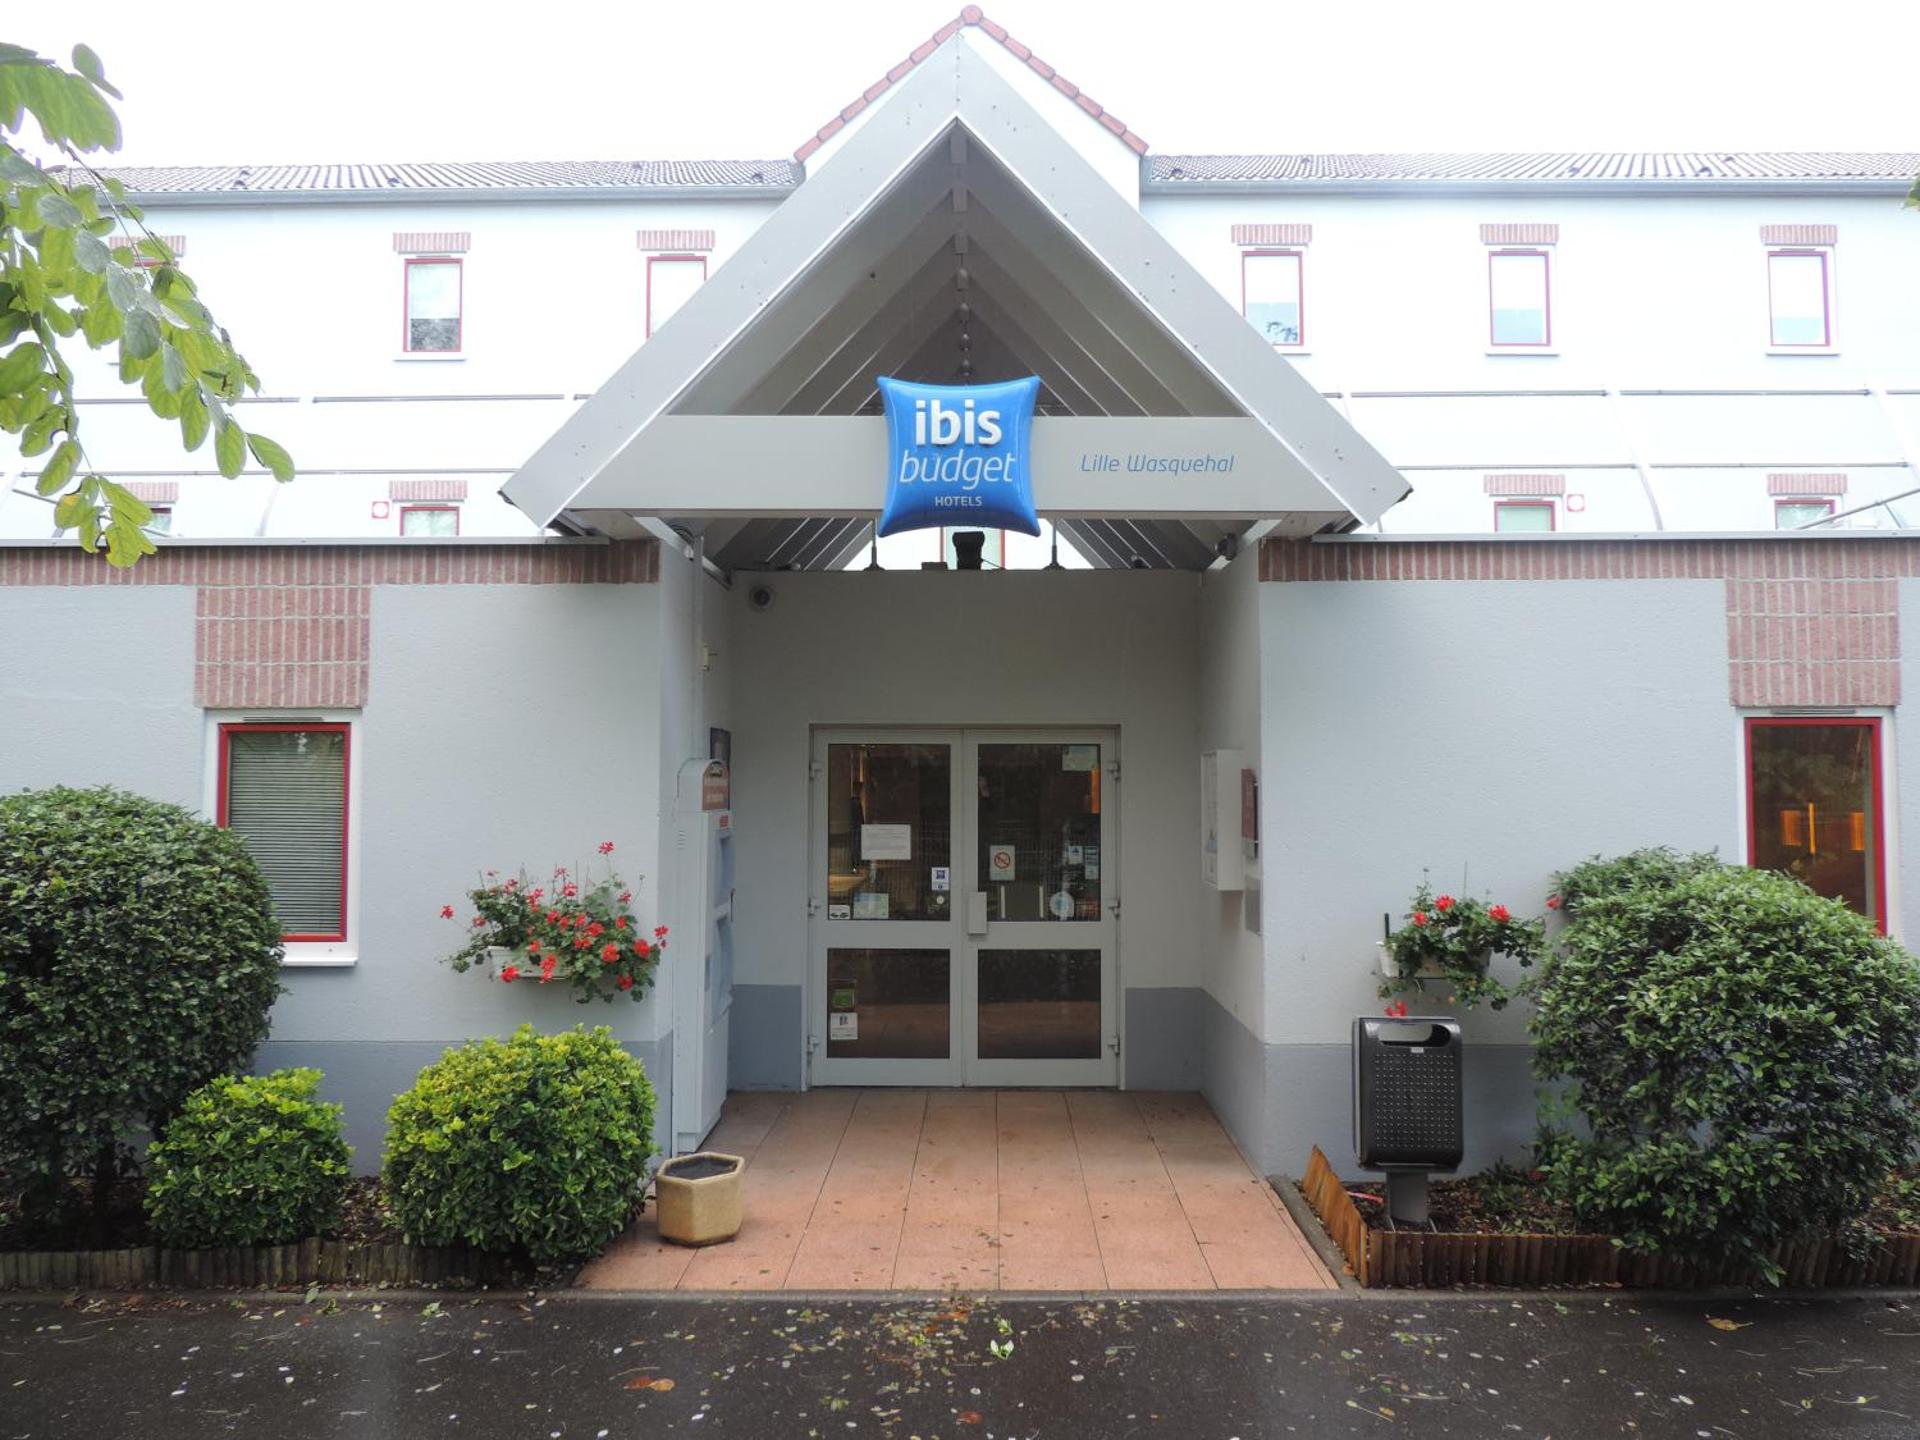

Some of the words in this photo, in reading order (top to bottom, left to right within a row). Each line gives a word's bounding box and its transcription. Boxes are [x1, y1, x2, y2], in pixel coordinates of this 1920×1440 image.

[915, 399, 1002, 446] ibis
[899, 449, 1016, 490] budget
[1080, 454, 1120, 473] Lille
[1127, 454, 1235, 477] Wasquehal
[934, 495, 983, 507] HOTELS
